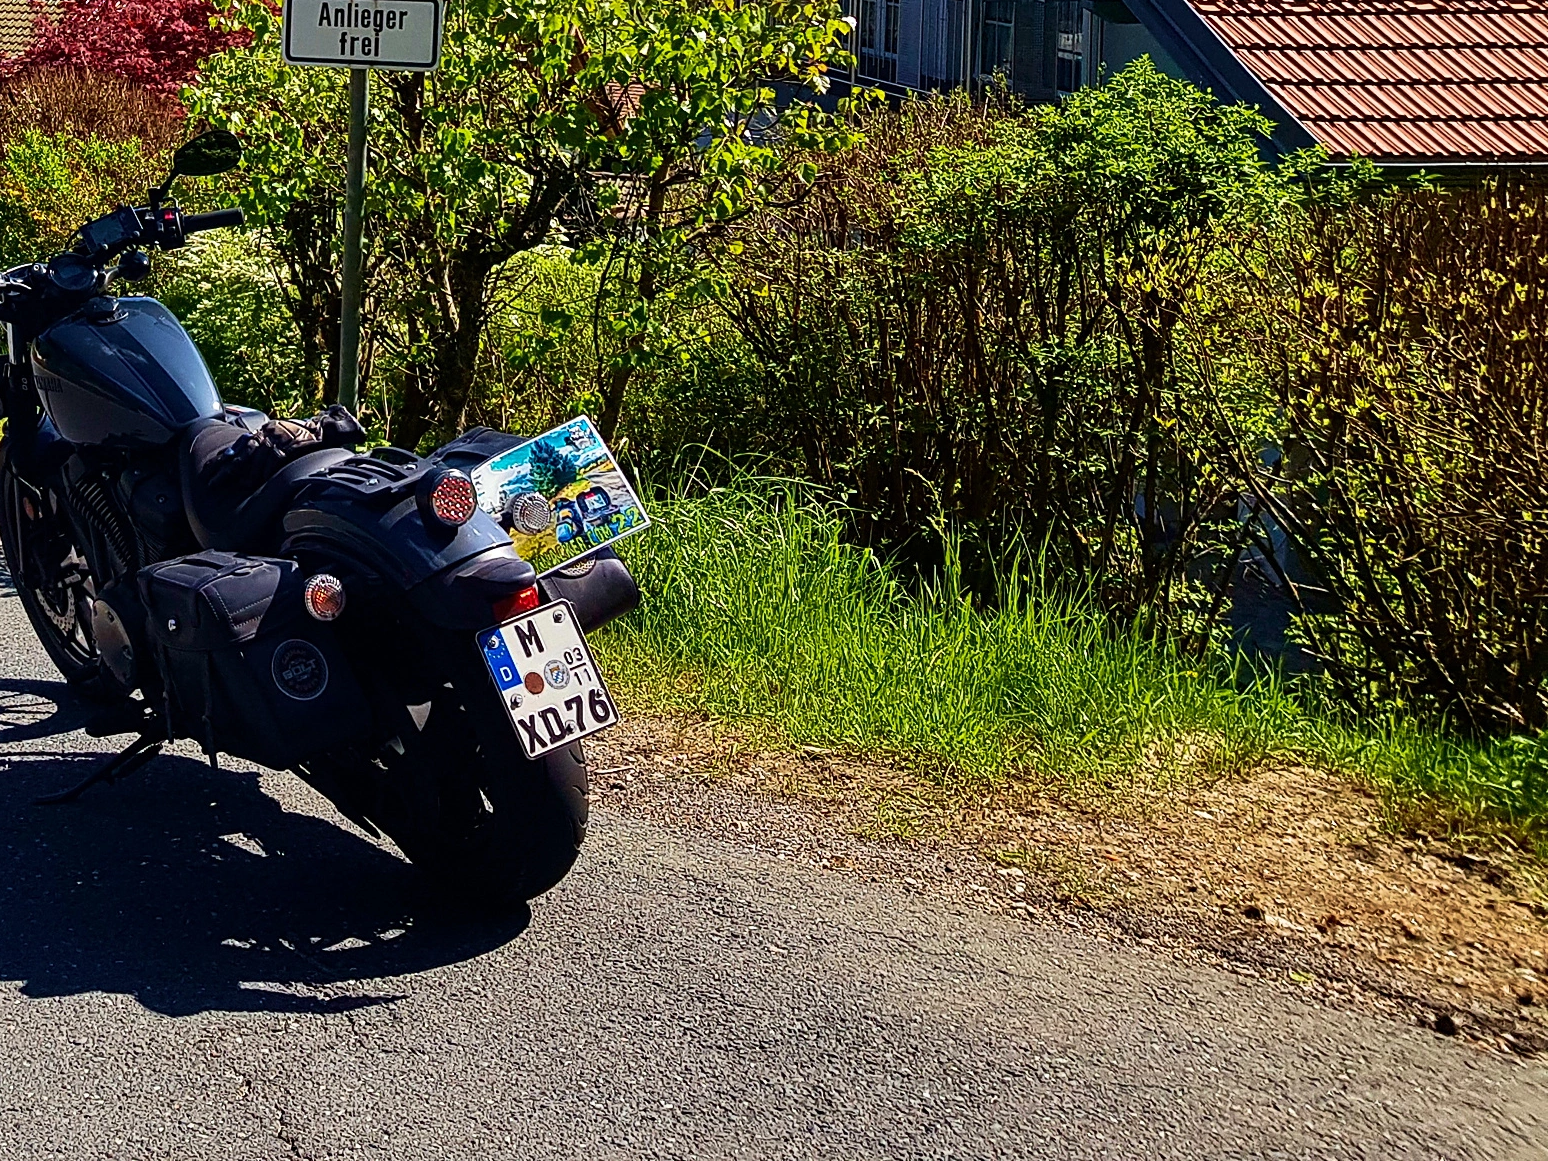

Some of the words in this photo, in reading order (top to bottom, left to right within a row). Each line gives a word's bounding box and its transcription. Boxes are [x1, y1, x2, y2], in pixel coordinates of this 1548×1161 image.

[318, 2, 408, 32] Anlieger
[339, 32, 380, 57] frei
[514, 619, 545, 658] M
[564, 647, 584, 665] 03
[500, 666, 513, 682] D
[573, 668, 592, 686] 11
